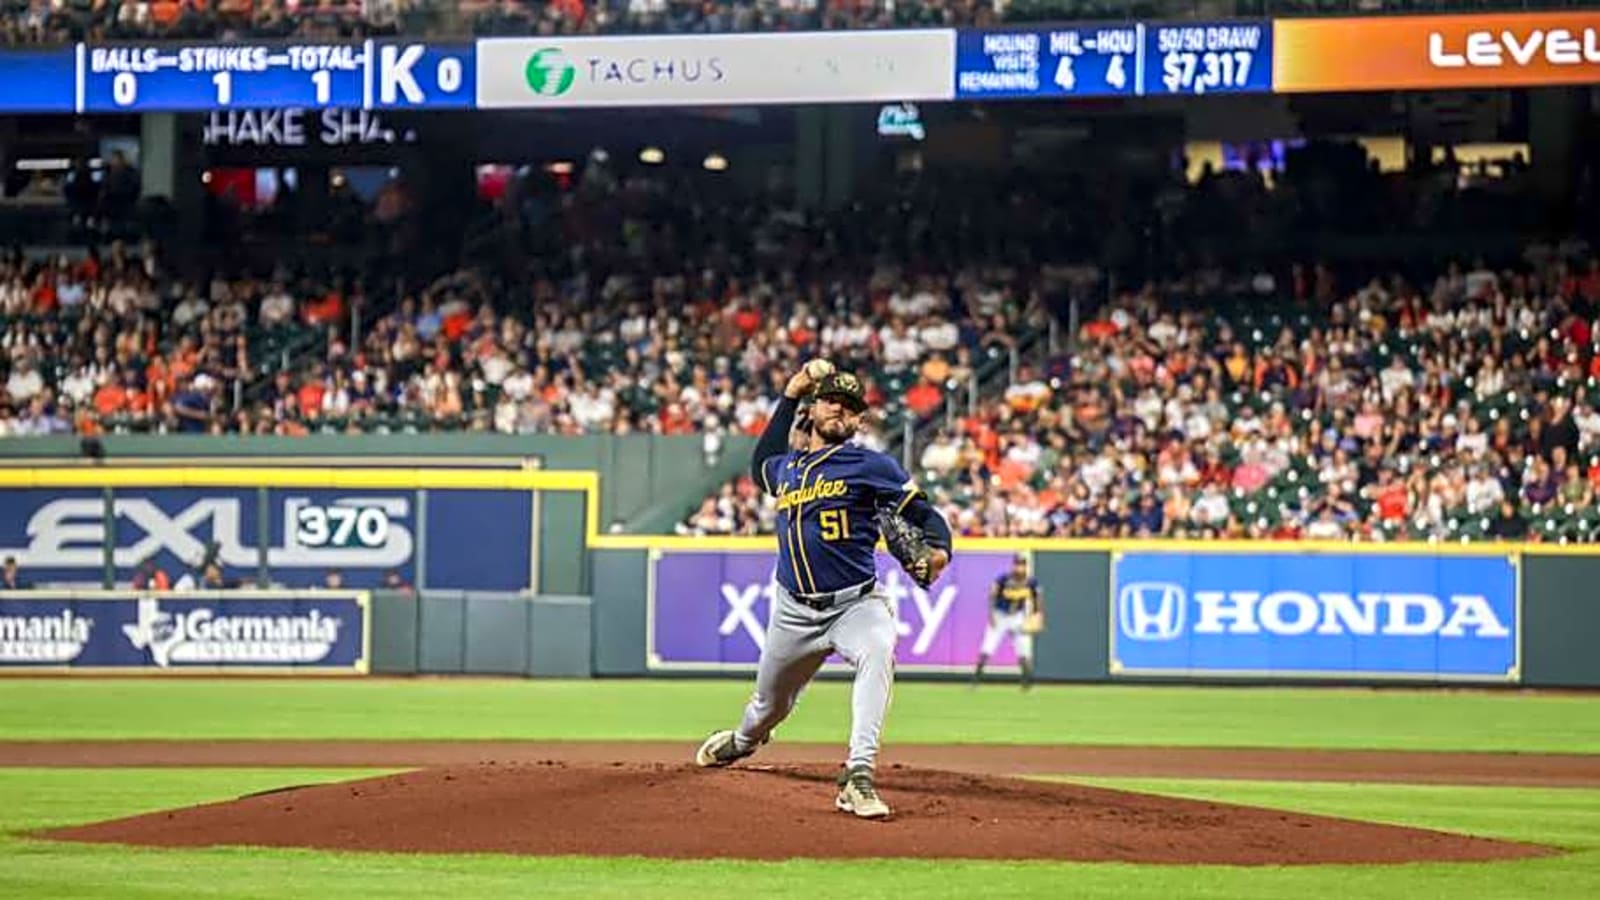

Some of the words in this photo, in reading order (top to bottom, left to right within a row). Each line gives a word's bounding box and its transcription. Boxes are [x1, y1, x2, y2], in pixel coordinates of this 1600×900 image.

[1158, 27, 1205, 51] 50/50
[1206, 25, 1260, 50] DRAW
[113, 72, 137, 106] 0
[213, 71, 231, 105] 1
[312, 70, 330, 104] 1
[381, 45, 425, 103] K
[437, 57, 462, 93] 0
[587, 57, 725, 83] TACHUS
[1054, 55, 1076, 90] 4
[1106, 54, 1126, 89] 4
[1163, 50, 1252, 94] $7,317
[203, 109, 305, 144] HAKE
[0, 497, 413, 567] EXUS
[298, 507, 389, 547] 370
[820, 509, 849, 541] 51
[186, 608, 338, 643] Germania
[1193, 591, 1508, 637] HONDA
